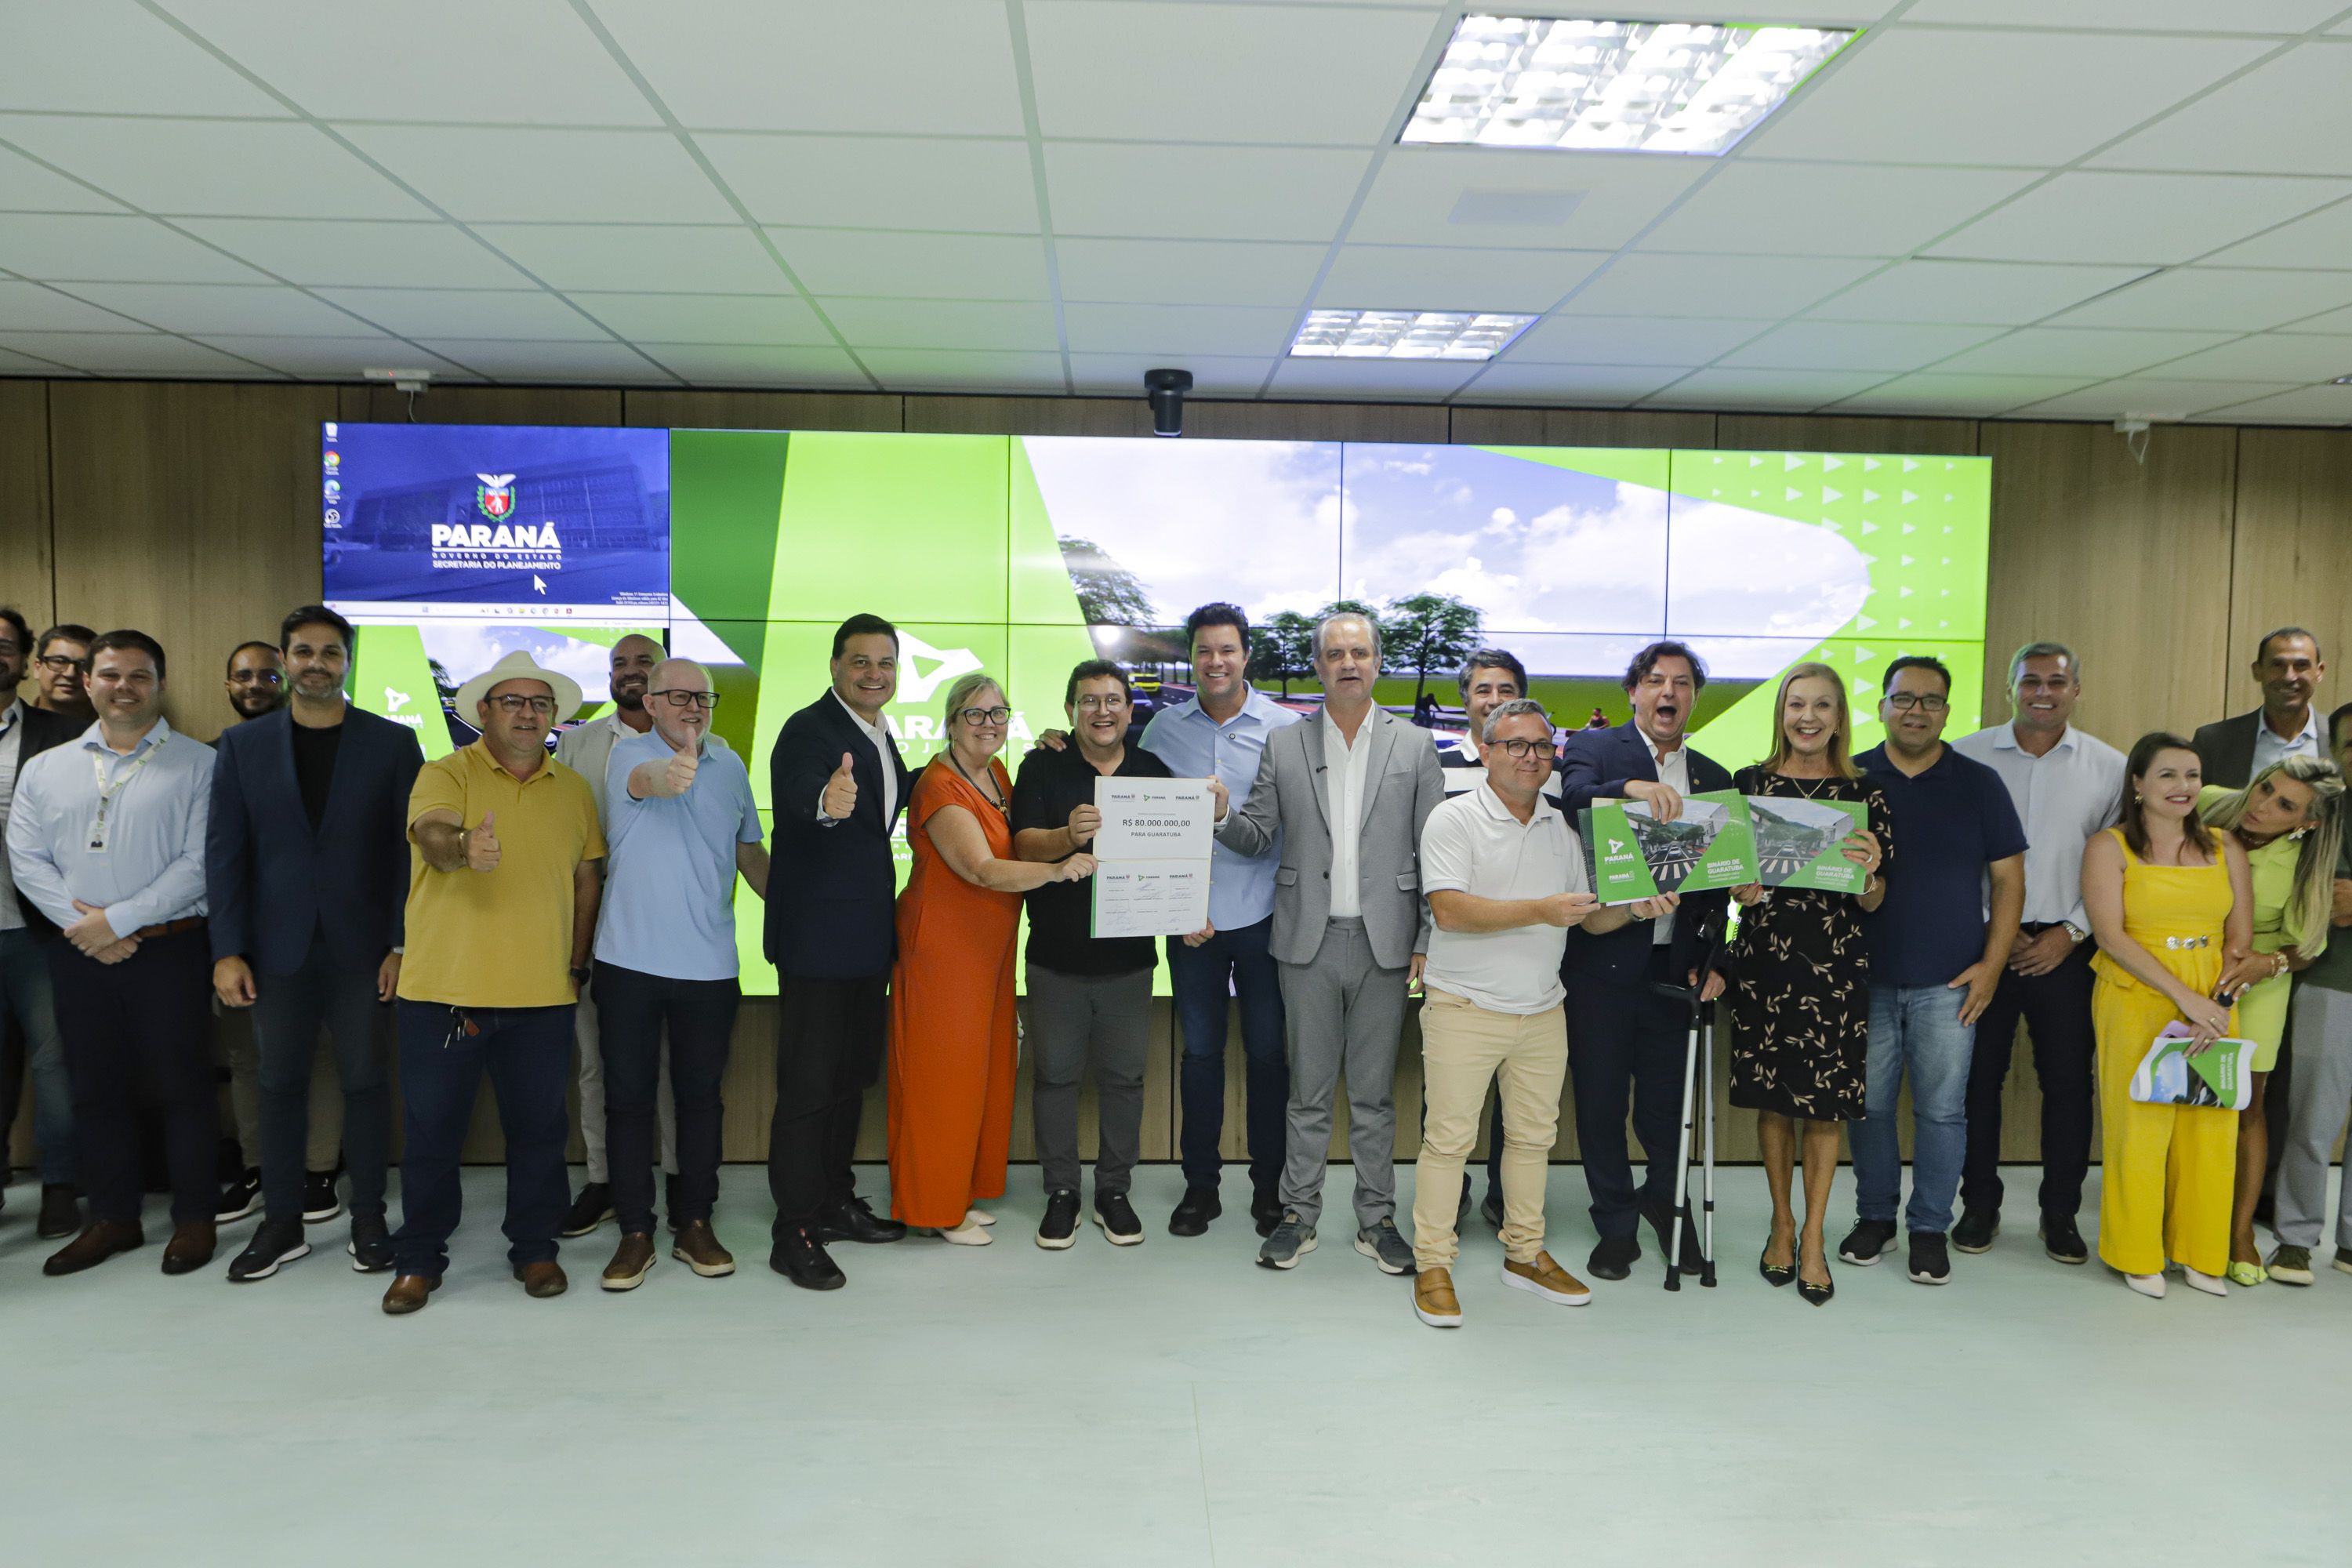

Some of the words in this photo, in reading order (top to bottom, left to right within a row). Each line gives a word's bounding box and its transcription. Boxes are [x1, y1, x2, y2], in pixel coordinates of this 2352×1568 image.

[431, 521, 561, 548] PARANÁ
[432, 560, 483, 569] SECRETARIA
[483, 561, 496, 569] DO
[497, 561, 562, 570] PLANEJAMENTO
[1123, 818, 1133, 827] R$
[1134, 819, 1191, 828] 80.000.000,00
[1604, 852, 1634, 862] PARANÁ
[1707, 860, 1731, 869] BINÁRIO
[1708, 865, 1744, 874] GUARATUBA
[1816, 871, 1855, 880] GUARATUBA
